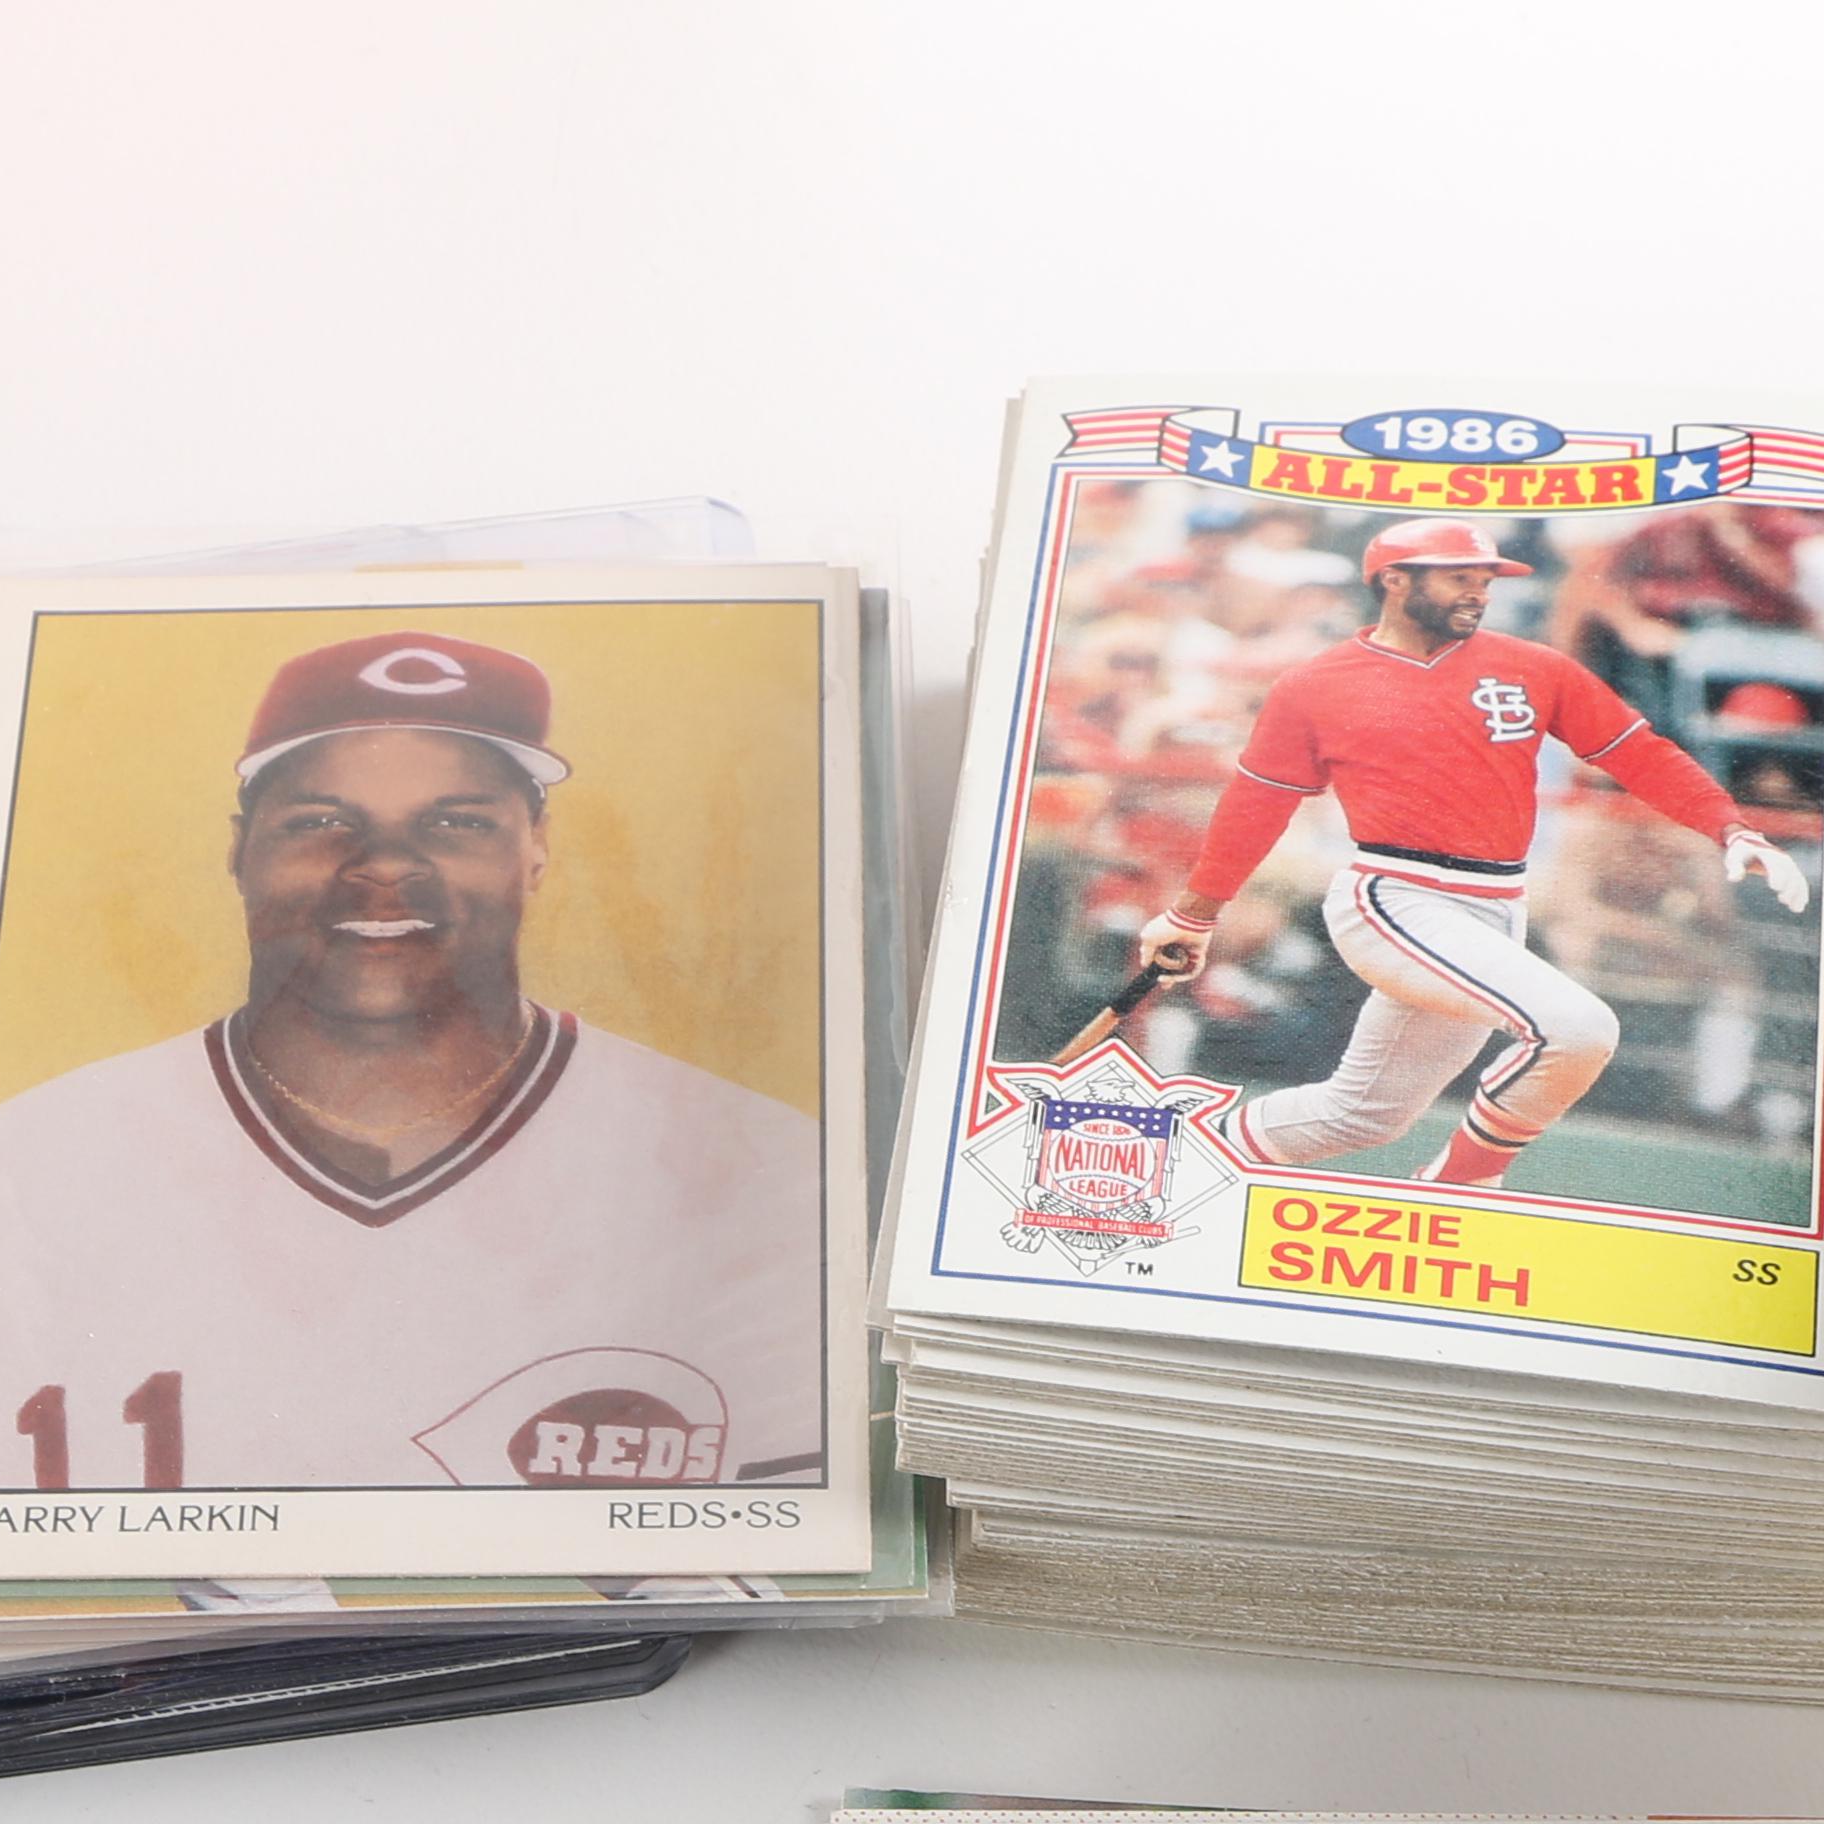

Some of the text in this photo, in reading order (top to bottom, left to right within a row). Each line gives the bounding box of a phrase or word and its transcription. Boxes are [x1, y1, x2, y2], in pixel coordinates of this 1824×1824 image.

[1374, 416, 1539, 455] 1986
[1261, 452, 1644, 507] ALL-STAR
[1054, 1133, 1148, 1182] NATIONAL
[1069, 1179, 1129, 1199] LEAGUE
[1272, 1196, 1462, 1249] OZZIE
[1125, 1261, 1154, 1276] TM
[1267, 1241, 1531, 1308] SMITH
[1733, 1258, 1781, 1287] SS
[16, 1370, 184, 1490] 11
[528, 1421, 722, 1482] REDS
[118, 1503, 281, 1532] LARKIN
